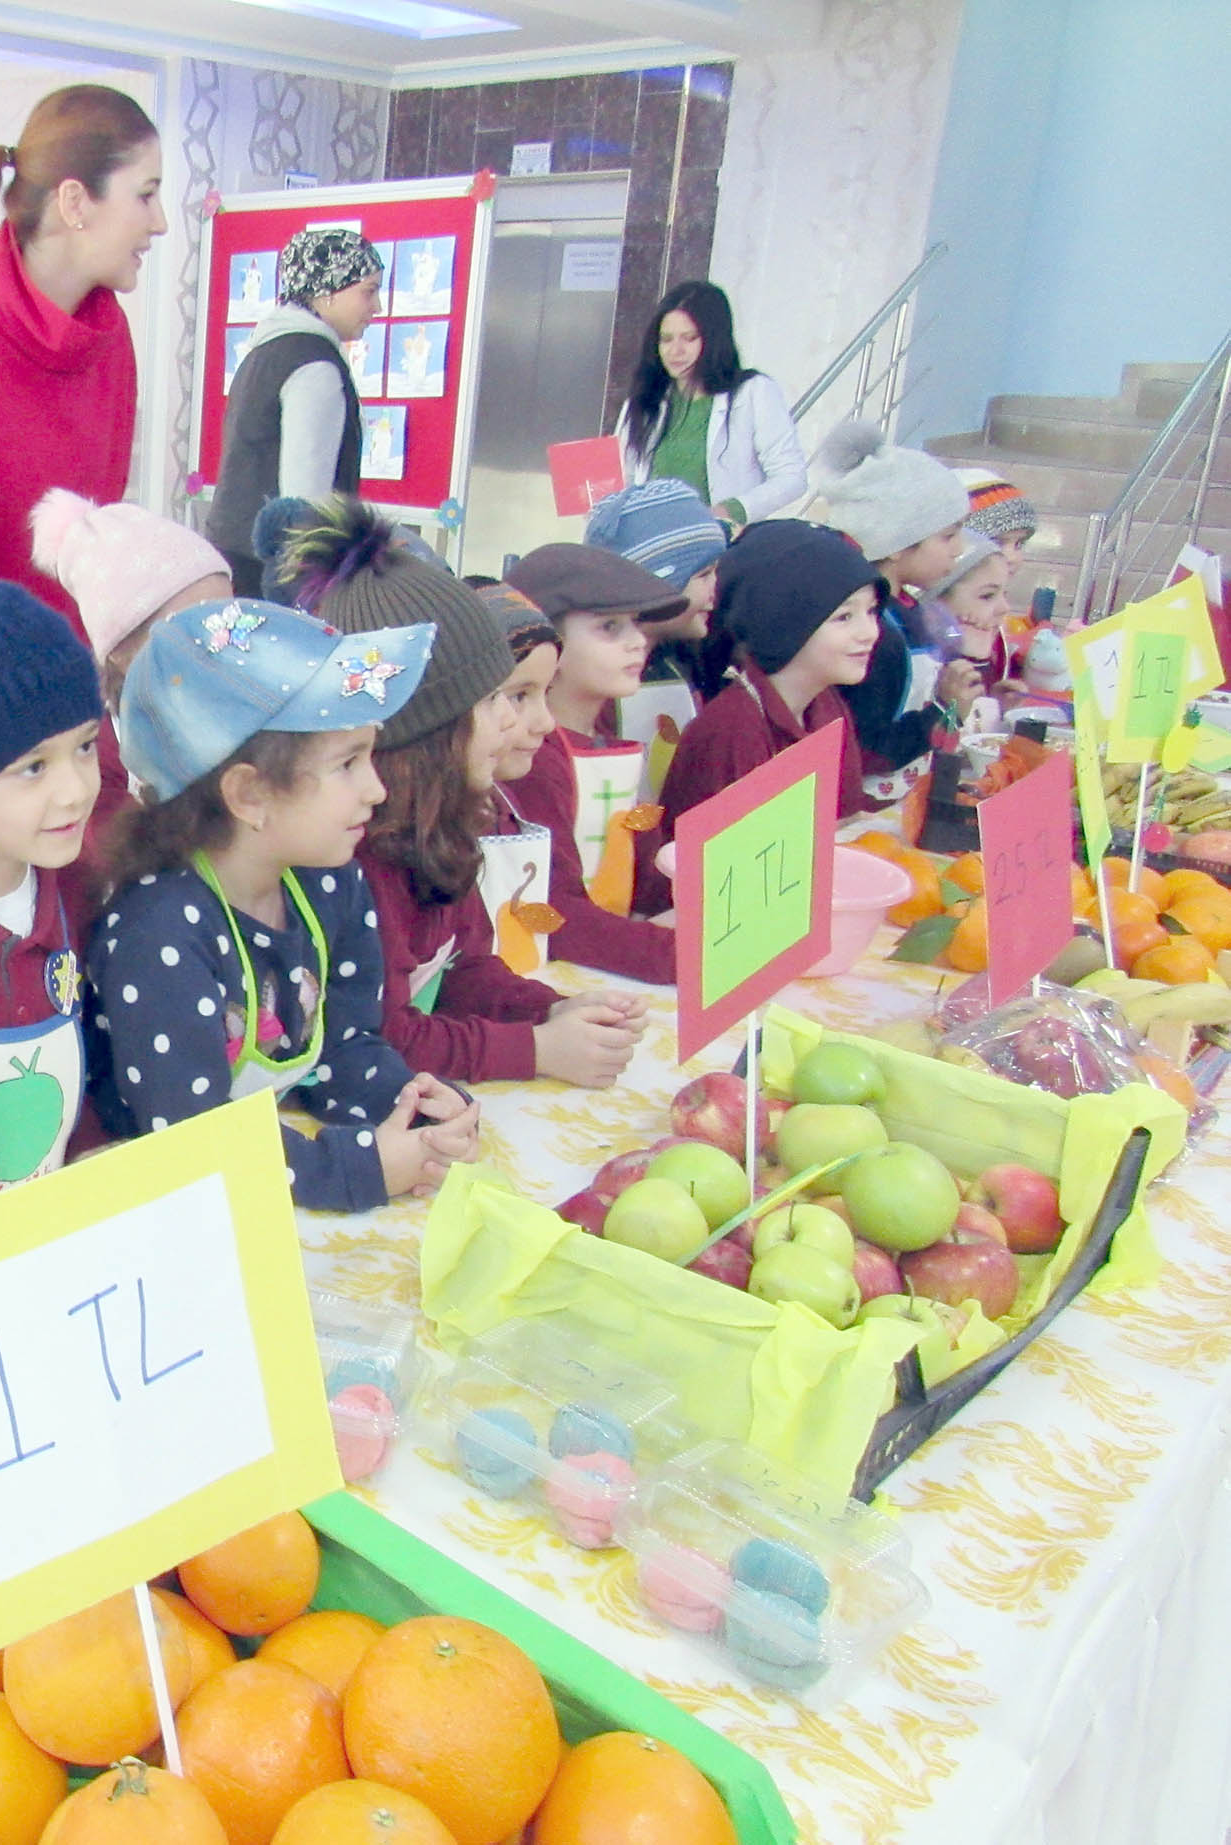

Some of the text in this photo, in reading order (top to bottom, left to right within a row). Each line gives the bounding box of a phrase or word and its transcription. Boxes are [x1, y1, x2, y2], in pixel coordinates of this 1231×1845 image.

[1132, 651, 1147, 699] 1
[713, 839, 801, 947] 1 TL
[67, 1276, 204, 1402] TL
